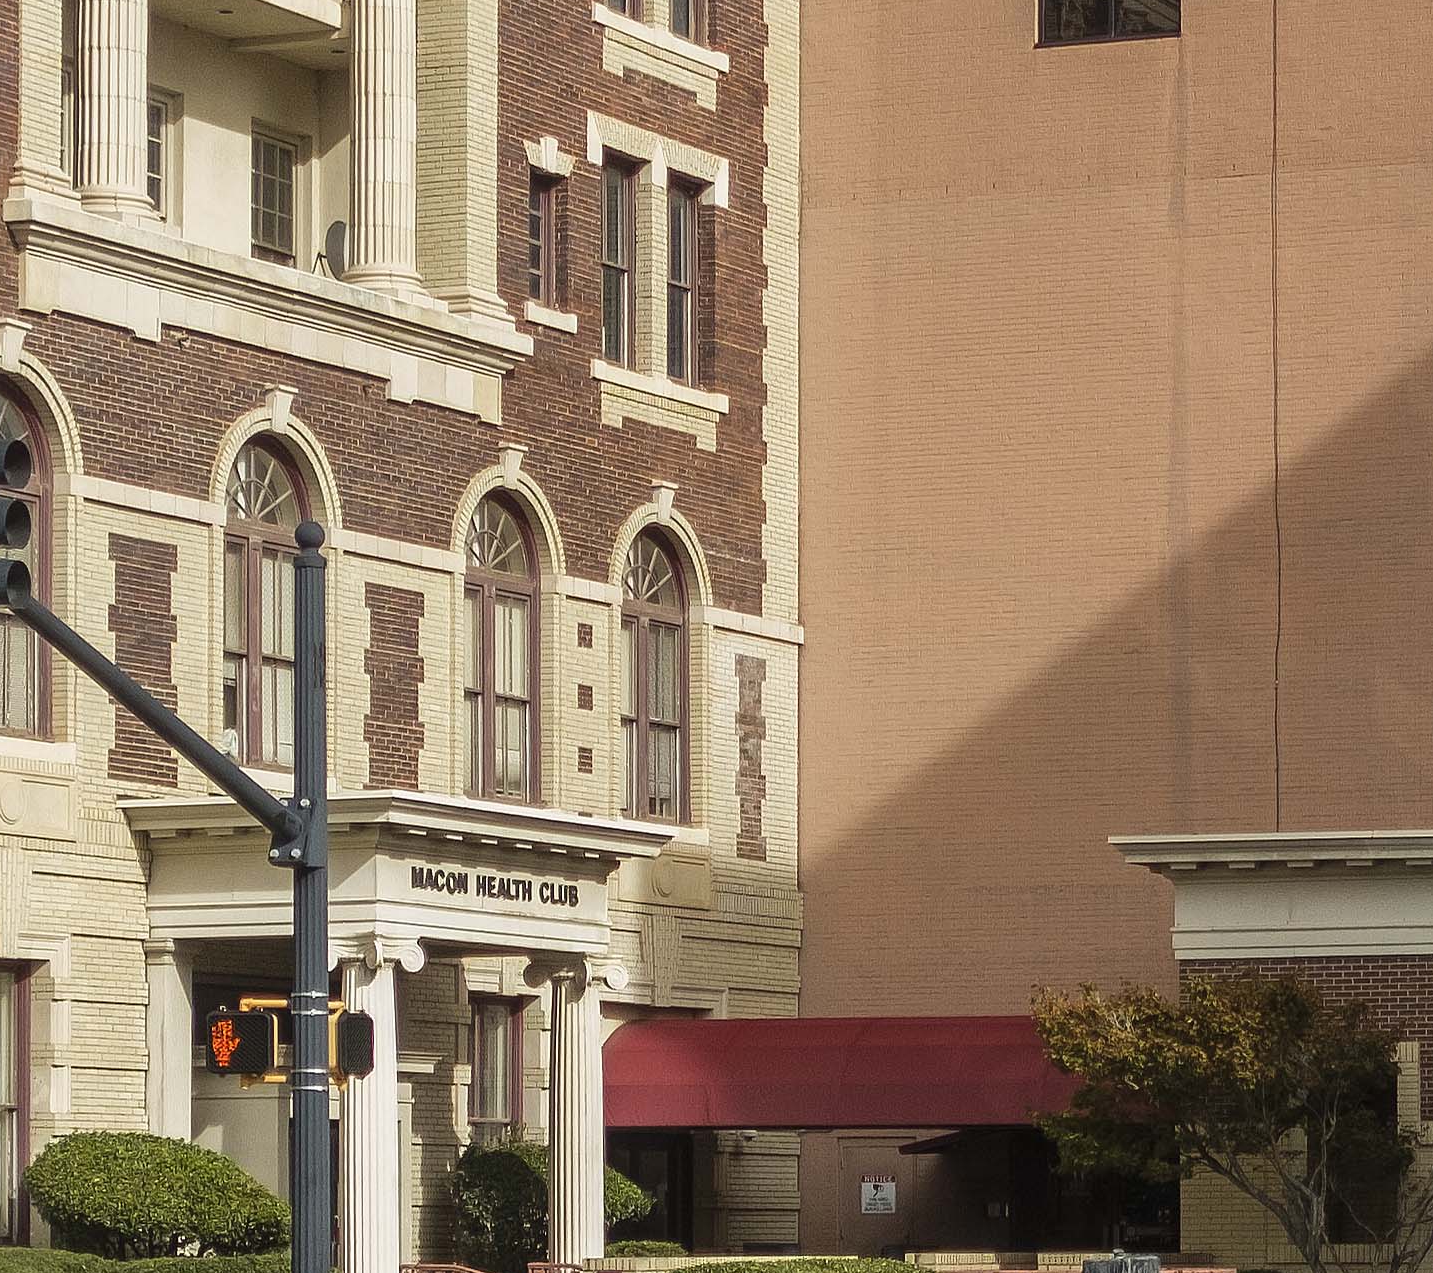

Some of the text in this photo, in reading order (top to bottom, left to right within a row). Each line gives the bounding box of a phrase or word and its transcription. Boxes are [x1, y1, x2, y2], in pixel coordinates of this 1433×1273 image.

[411, 866, 579, 907] MACON HEALTH CLUB
